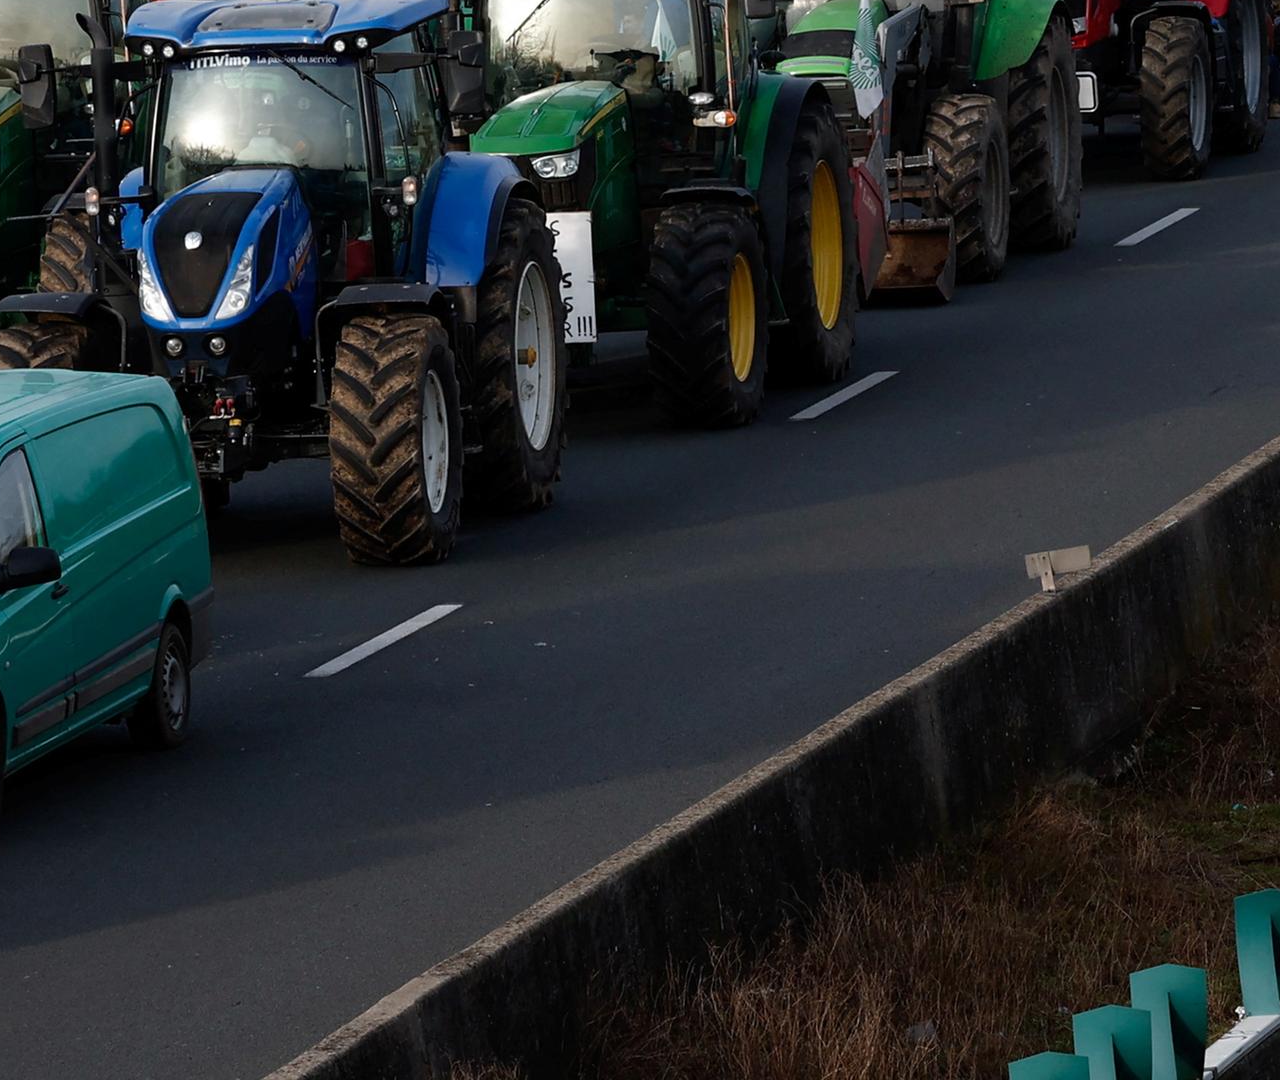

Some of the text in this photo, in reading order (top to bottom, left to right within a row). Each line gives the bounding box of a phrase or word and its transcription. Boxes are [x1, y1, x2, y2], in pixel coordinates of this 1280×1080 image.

[257, 55, 266, 64] La
[298, 54, 308, 64] du
[309, 54, 338, 64] service
